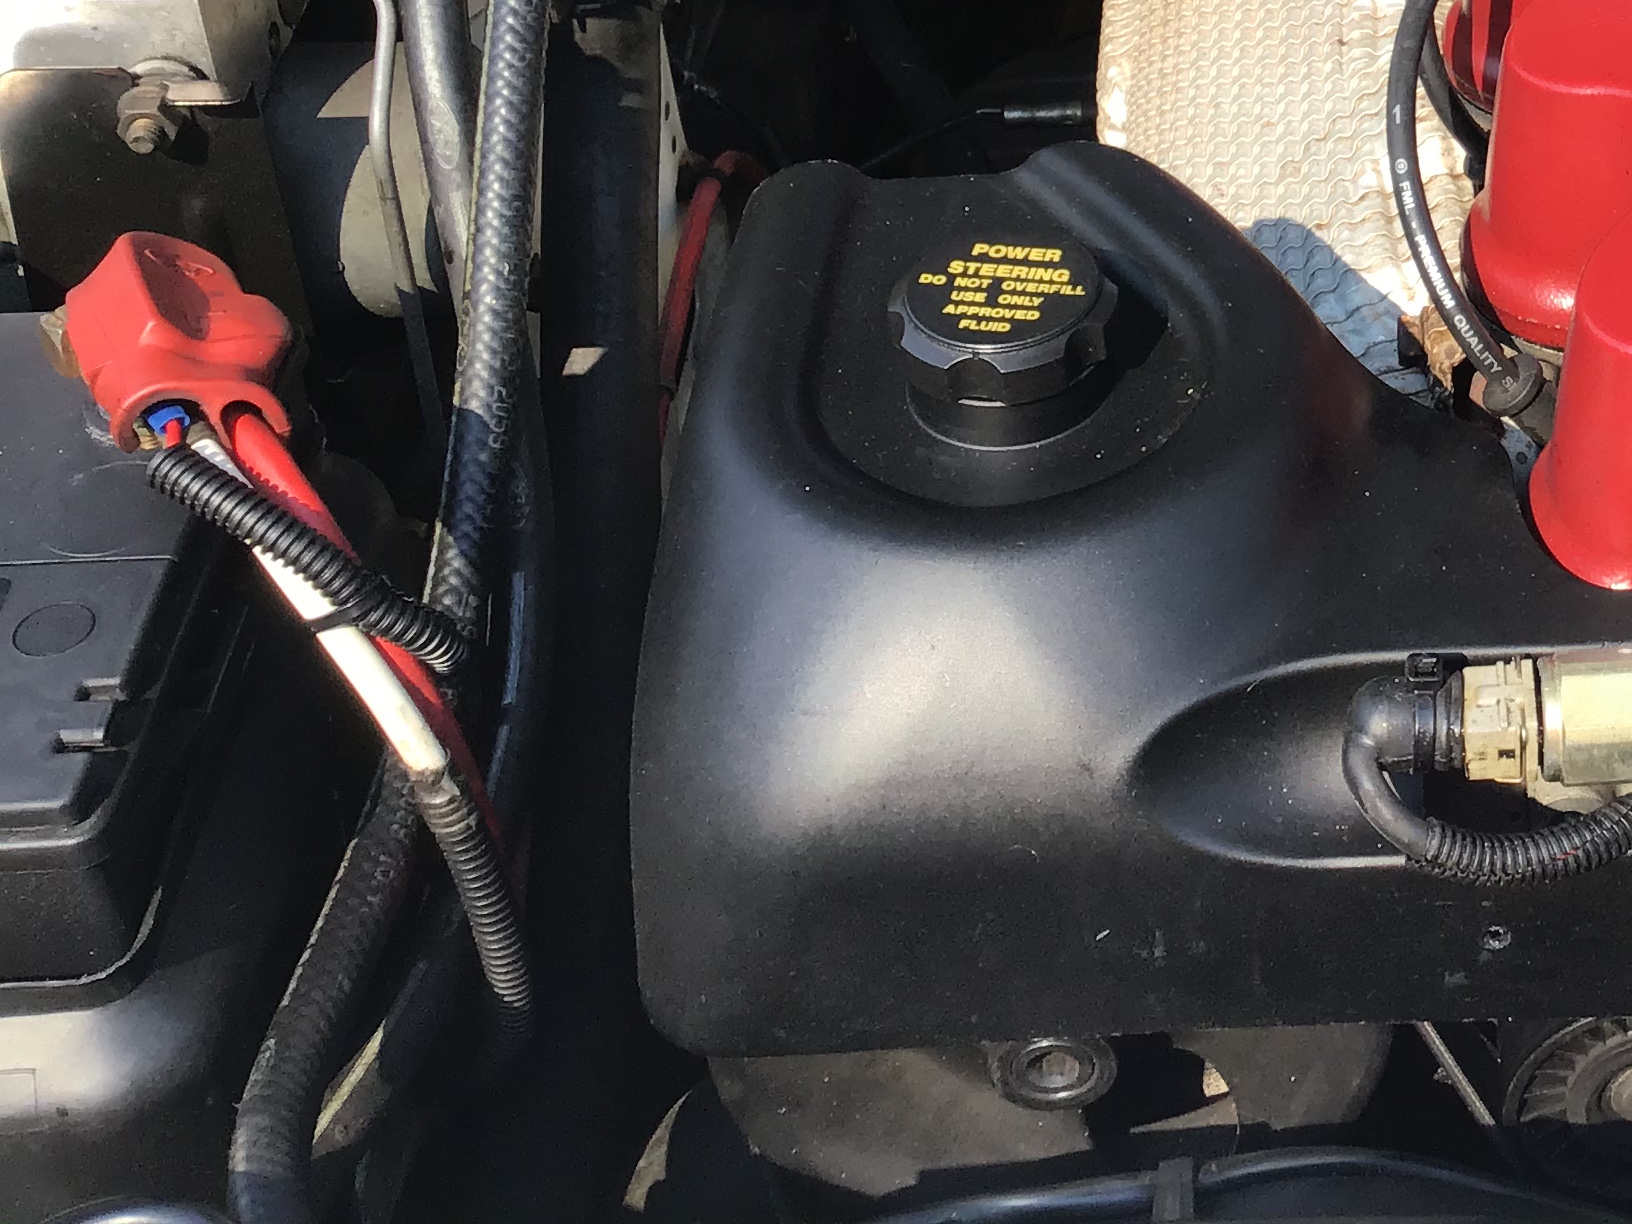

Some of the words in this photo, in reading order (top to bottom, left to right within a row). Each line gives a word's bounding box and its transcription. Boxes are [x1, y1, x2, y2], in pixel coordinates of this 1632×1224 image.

[971, 242, 1063, 263] POWER
[946, 259, 1071, 283] STEERING
[1399, 180, 1416, 216] FML
[1413, 233, 1457, 311] PREMIUM
[1452, 313, 1503, 374] QUALITY
[918, 272, 948, 286] DO
[953, 276, 993, 290] NOT
[1000, 279, 1086, 296] OVERFILL
[949, 289, 988, 304] USE
[997, 292, 1045, 308] ONLY
[941, 303, 1041, 322] APPROVED
[957, 318, 1012, 333] FLUID
